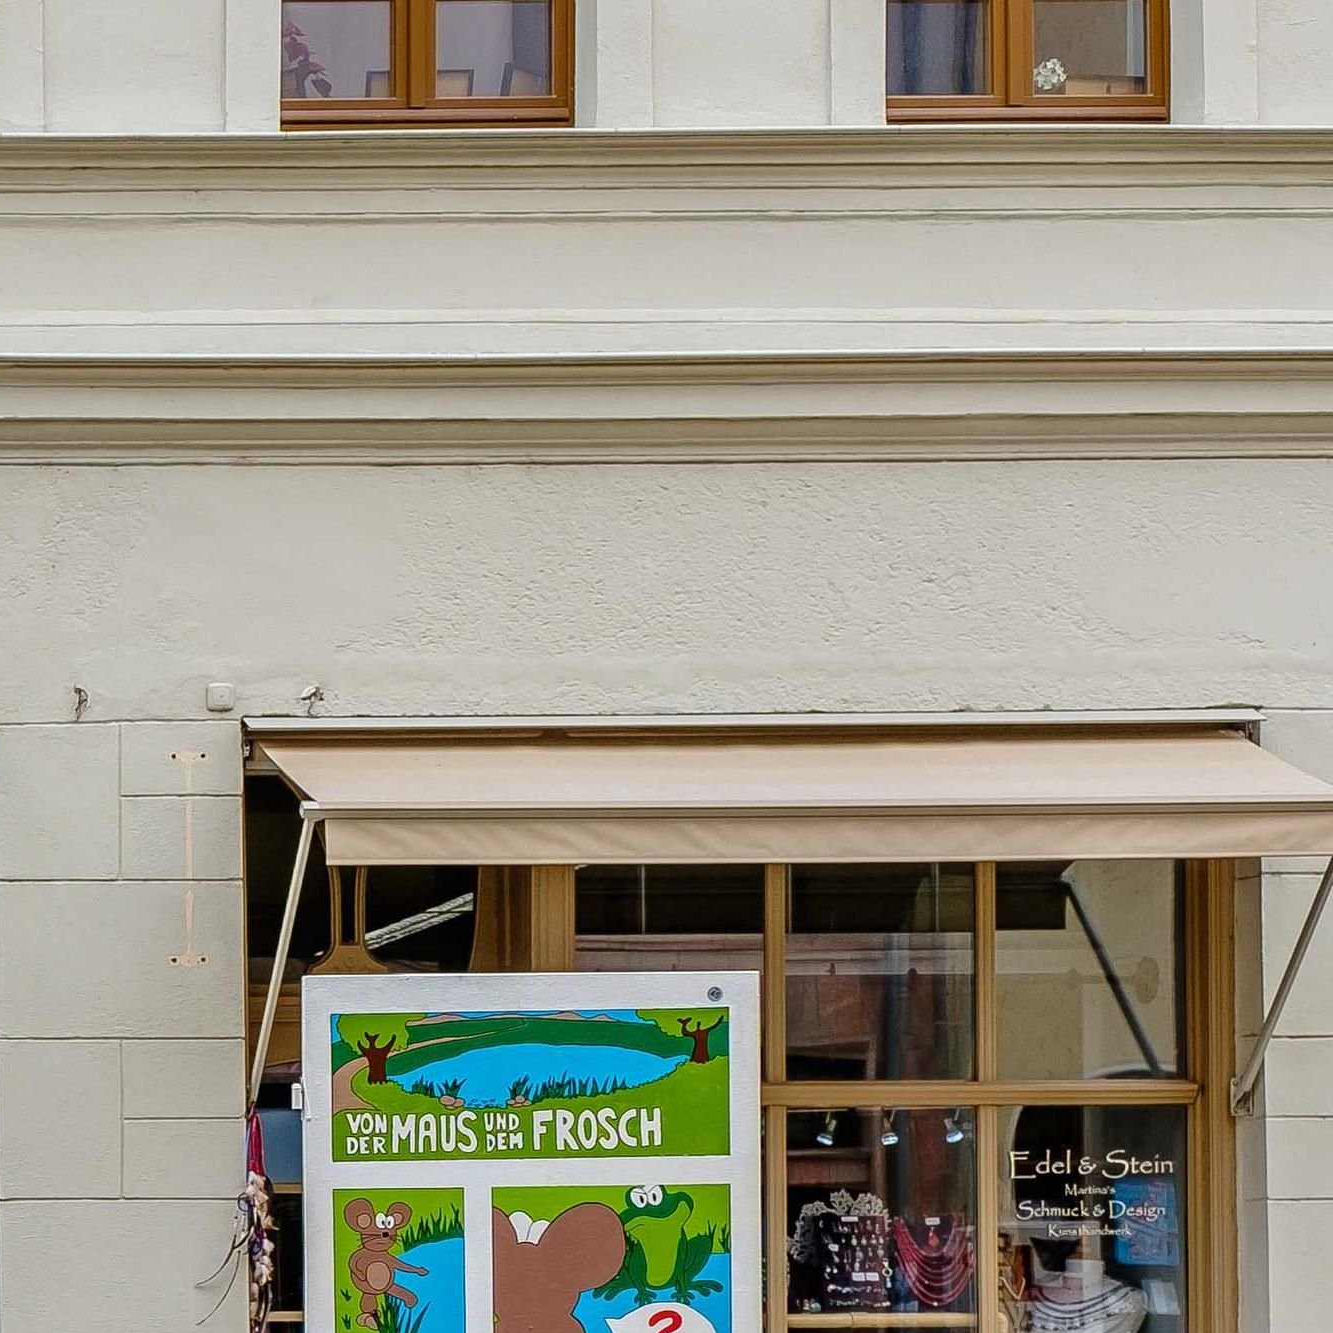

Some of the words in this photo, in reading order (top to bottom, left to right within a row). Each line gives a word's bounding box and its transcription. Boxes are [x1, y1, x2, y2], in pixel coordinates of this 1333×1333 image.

[346, 1113, 386, 1134] VON
[392, 1110, 479, 1153] MAUS
[484, 1112, 520, 1132] UND
[532, 1107, 662, 1151] FROSCH
[346, 1136, 386, 1154] DER
[486, 1131, 523, 1152] DEM
[1009, 1149, 1071, 1179] Edel
[1078, 1156, 1097, 1175] &
[1102, 1150, 1174, 1179] Stein
[1065, 1184, 1116, 1196] Martina's
[1016, 1200, 1090, 1220] Schmuck
[1093, 1204, 1105, 1217] &
[1108, 1200, 1166, 1222] Design
[1048, 1224, 1132, 1238] Kunsthandwerk
